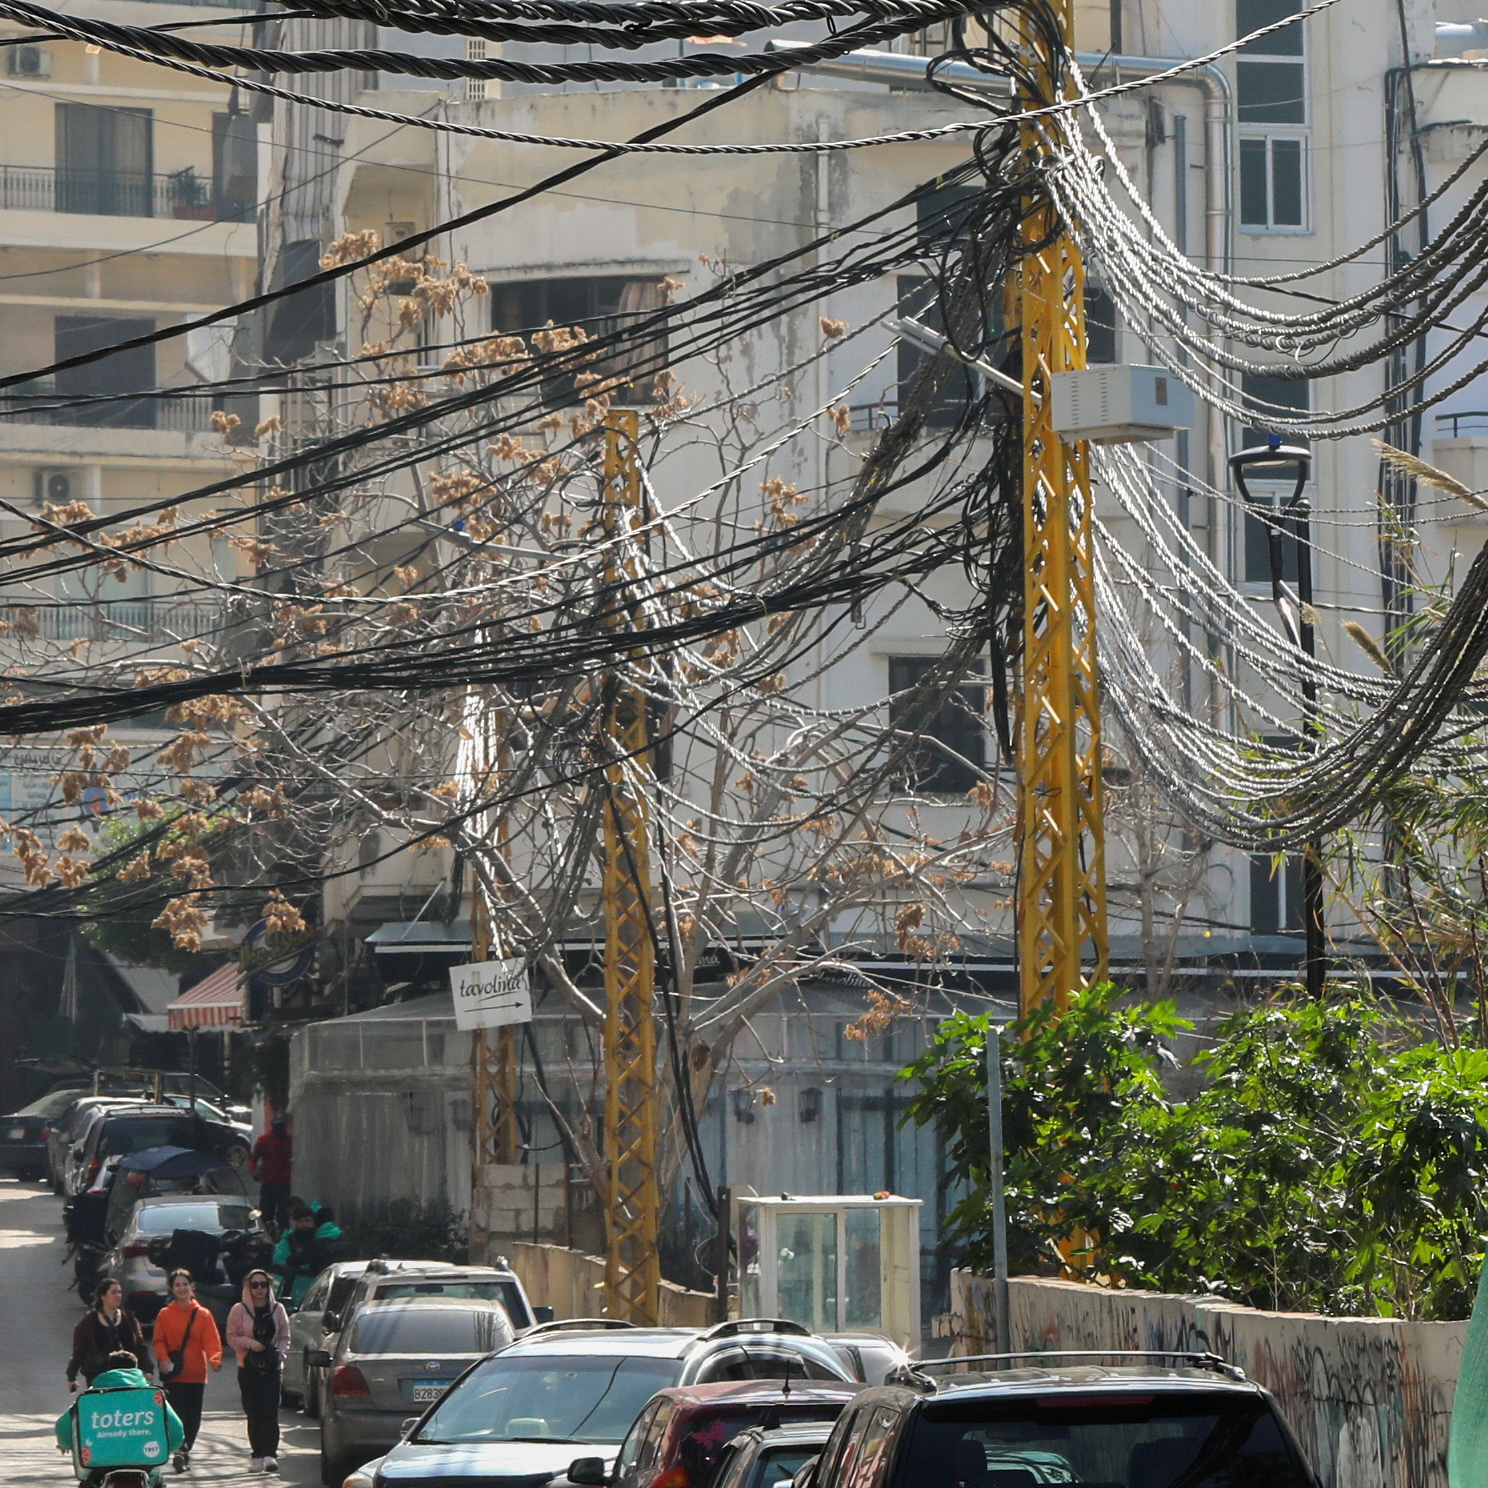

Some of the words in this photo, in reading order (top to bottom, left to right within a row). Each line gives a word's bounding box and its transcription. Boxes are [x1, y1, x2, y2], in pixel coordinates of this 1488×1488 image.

[460, 974, 521, 997] tavolina
[92, 1410, 154, 1429] toters
[97, 1429, 127, 1438] Already
[128, 1428, 152, 1436] there.
